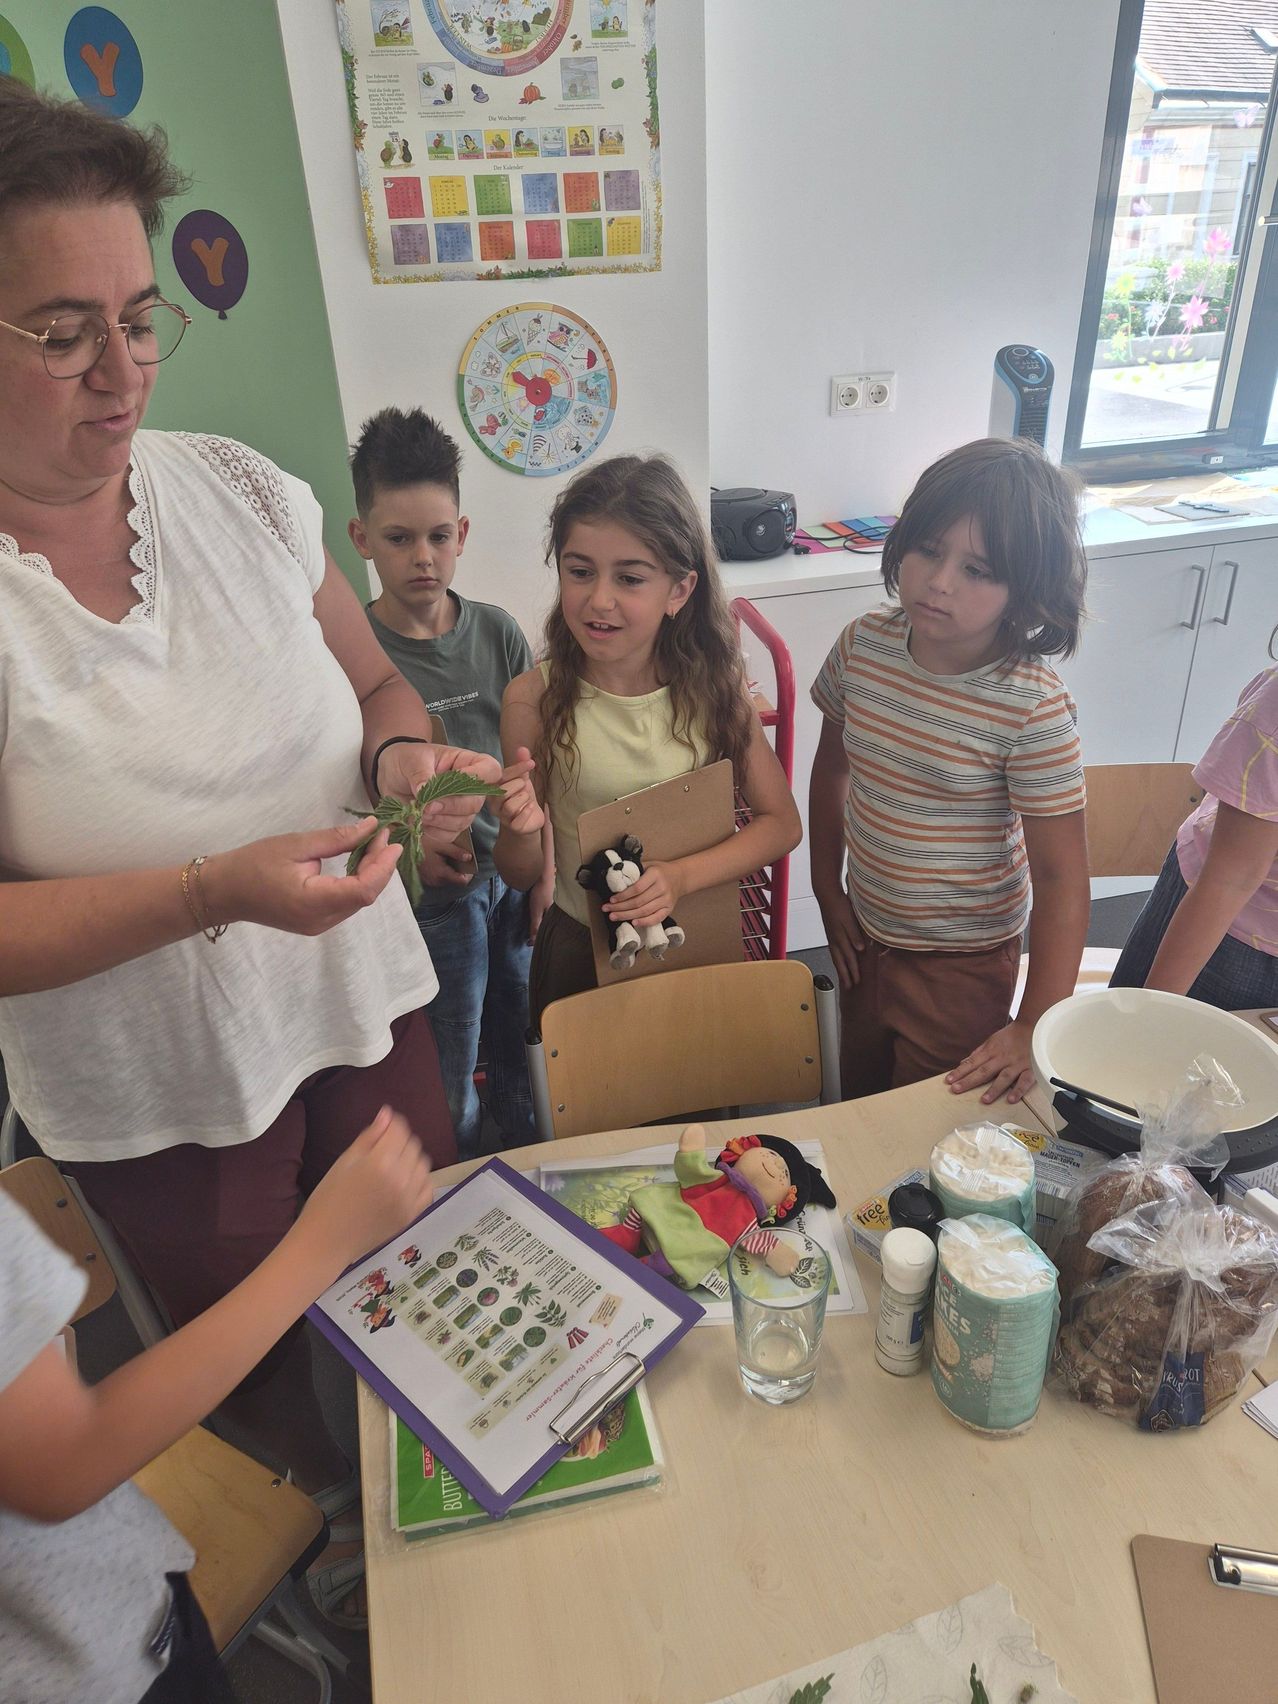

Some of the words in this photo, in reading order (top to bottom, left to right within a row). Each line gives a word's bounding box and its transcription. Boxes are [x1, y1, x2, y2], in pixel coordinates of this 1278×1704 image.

[80, 42, 120, 97] Y
[191, 238, 229, 286] Y
[462, 692, 479, 700] VIBES
[572, 1362, 587, 1376] für
[583, 1336, 615, 1367] Checkliste
[523, 1372, 576, 1422] Kräuter-Sammler
